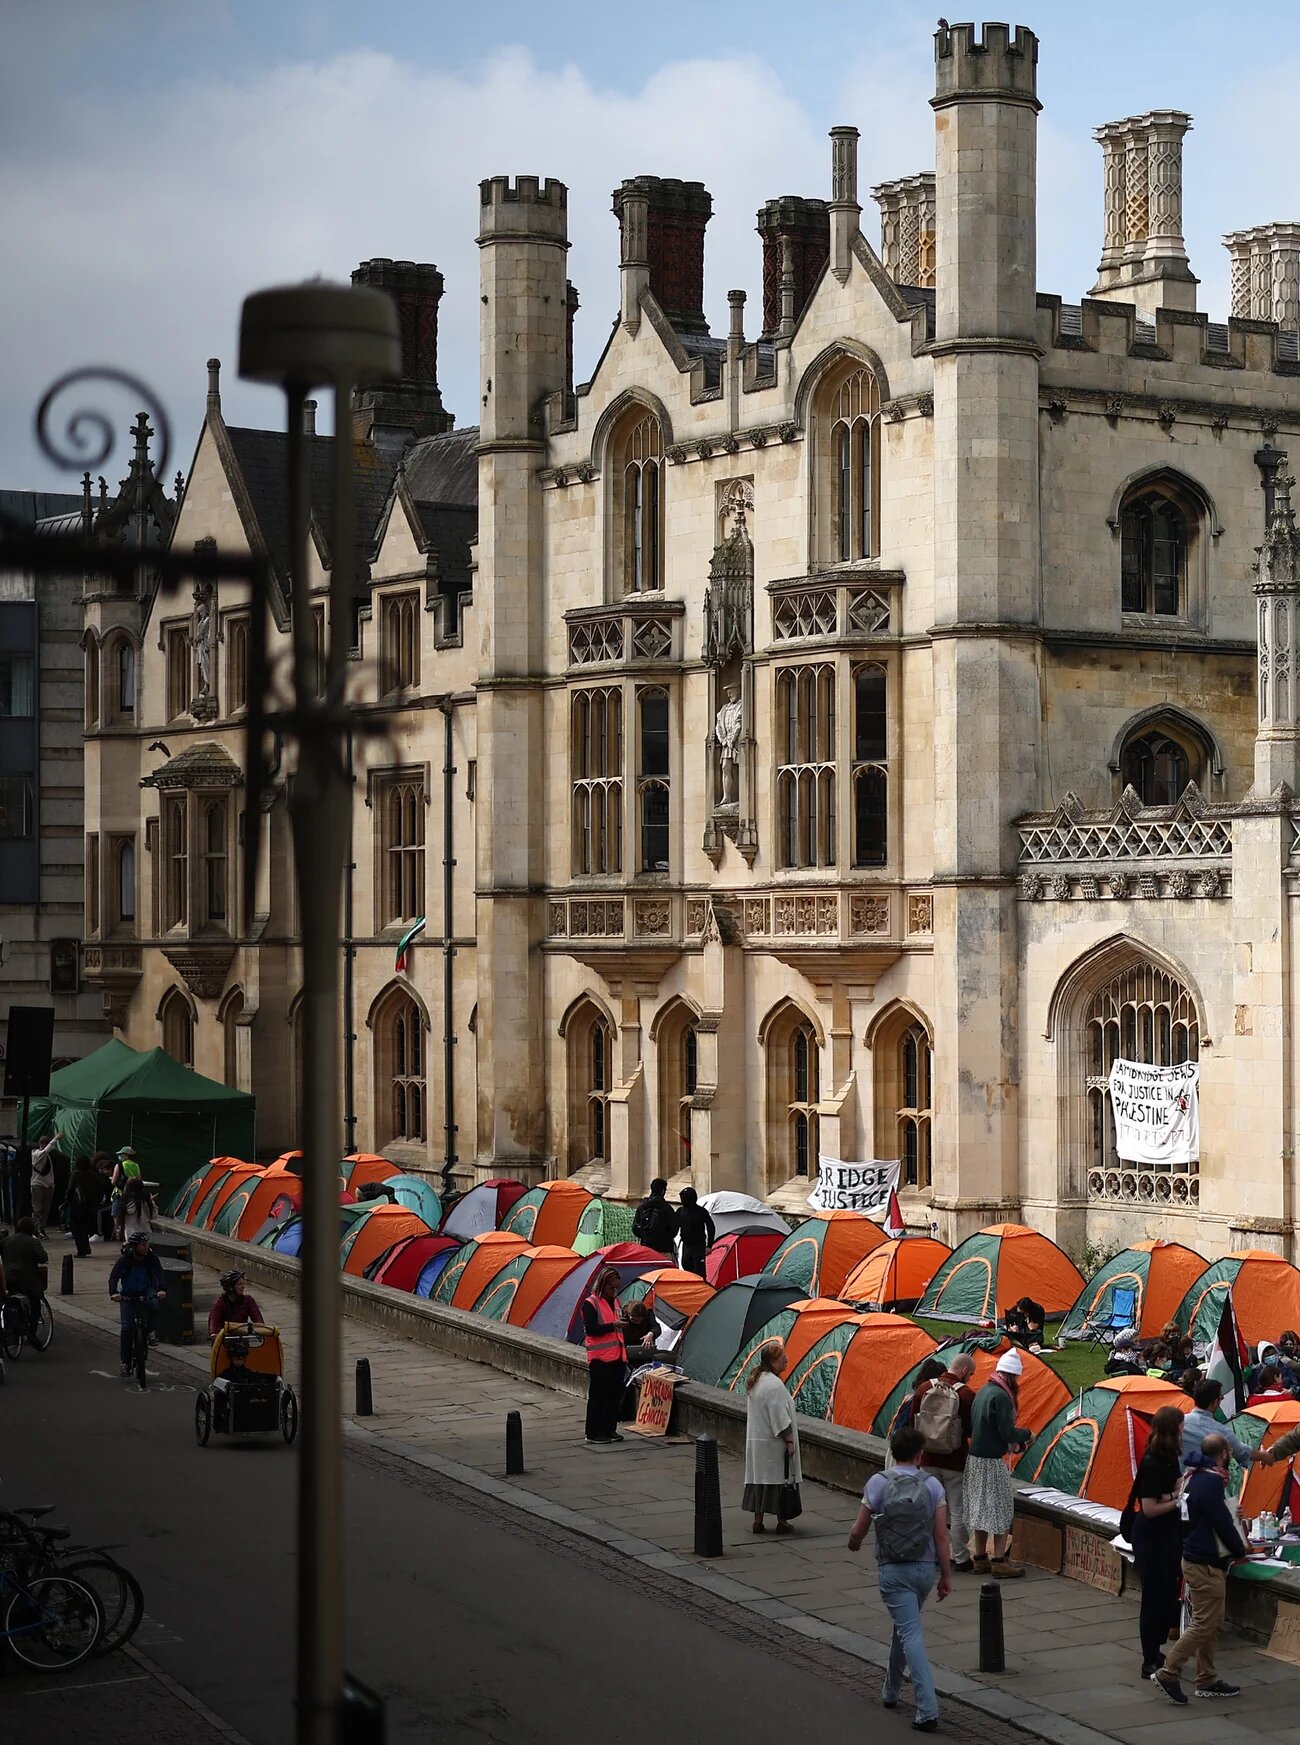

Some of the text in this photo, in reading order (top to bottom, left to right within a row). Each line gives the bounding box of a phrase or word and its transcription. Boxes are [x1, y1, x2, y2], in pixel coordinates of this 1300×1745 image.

[1113, 1079, 1175, 1101] FOR JUSTICE IN
[1114, 1096, 1170, 1126] PALESTINE
[821, 1189, 889, 1209] JUSTICE
